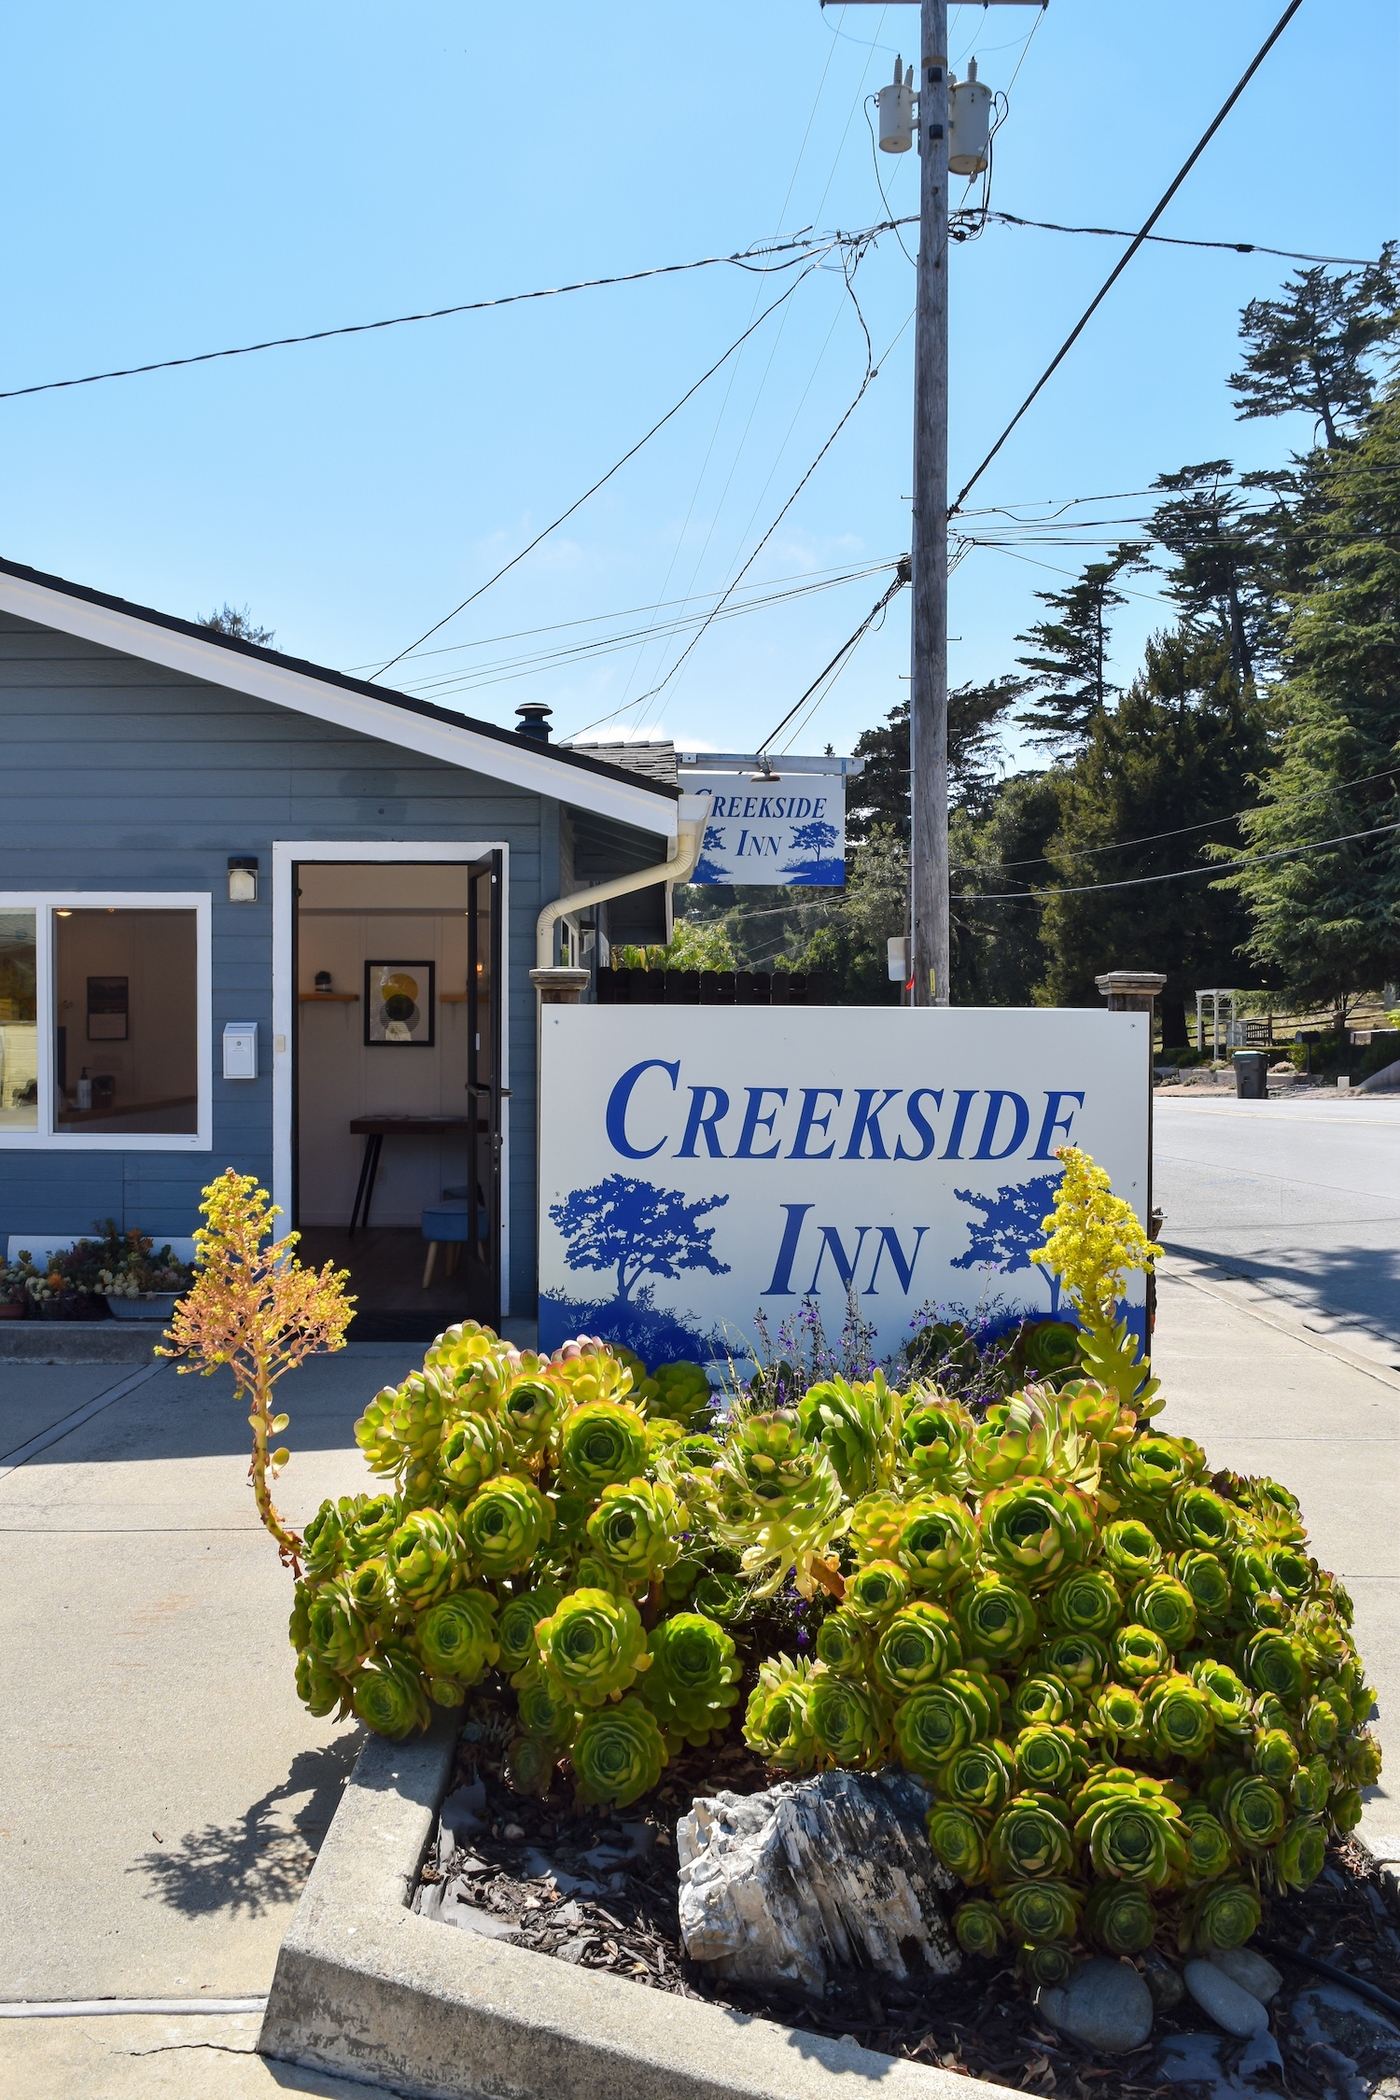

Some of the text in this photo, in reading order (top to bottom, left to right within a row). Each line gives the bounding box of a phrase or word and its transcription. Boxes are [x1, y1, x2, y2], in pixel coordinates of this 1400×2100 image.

[695, 788, 827, 818] REEKSIDE
[735, 829, 782, 857] INN
[605, 1059, 1086, 1162] CREEKSIDE
[760, 1203, 930, 1296] INN
